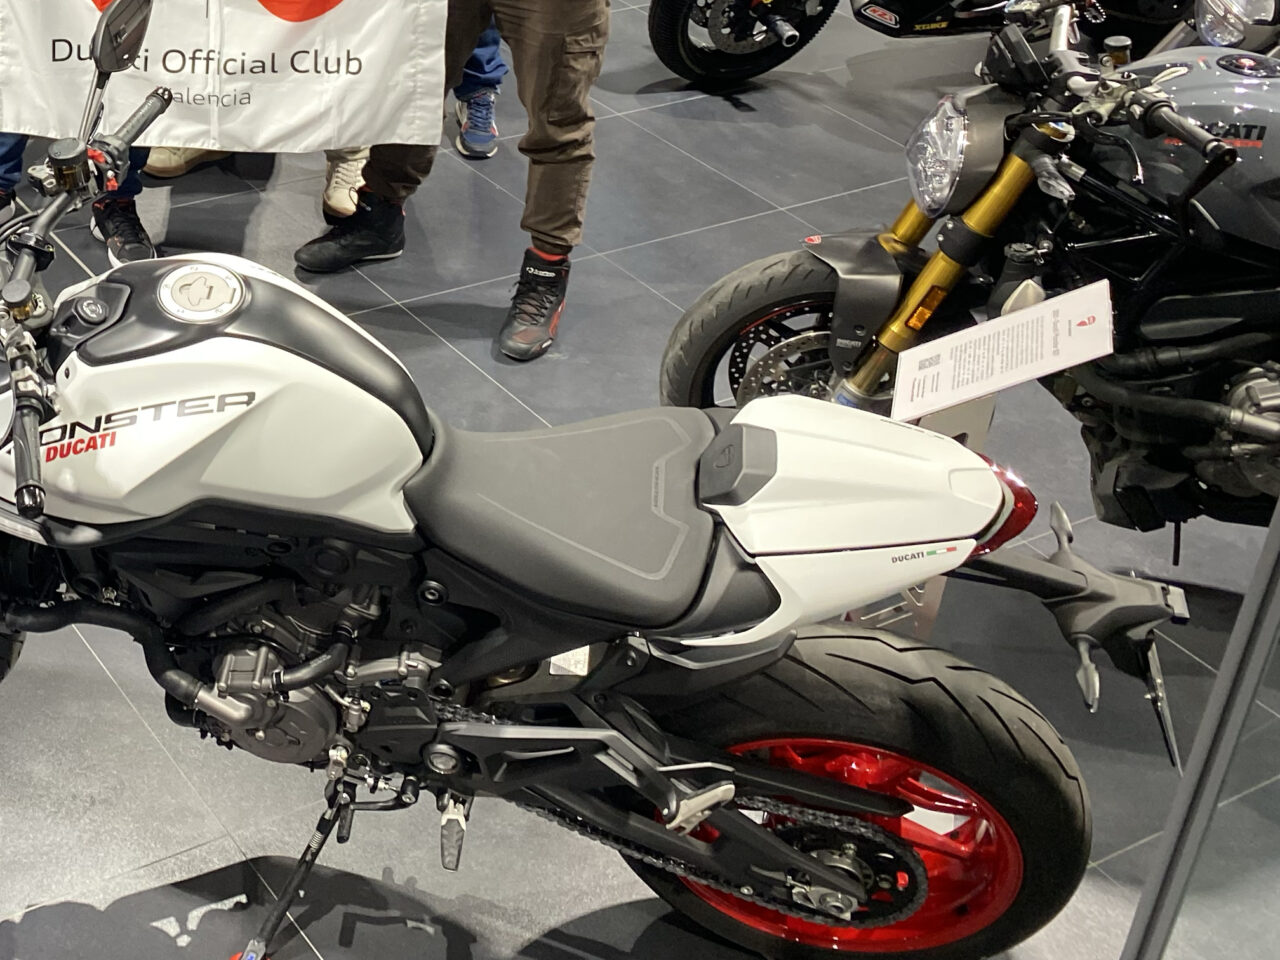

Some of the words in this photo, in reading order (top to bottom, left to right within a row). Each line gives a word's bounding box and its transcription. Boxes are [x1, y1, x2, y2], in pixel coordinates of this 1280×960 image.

[51, 38, 149, 72] Duti
[161, 49, 279, 75] Official
[290, 49, 363, 76] Club
[171, 88, 252, 107] alencia
[1200, 122, 1268, 141] CATI
[38, 391, 256, 447] ONSTER
[45, 431, 117, 464] DUCATI
[891, 551, 925, 564] DUCATI
